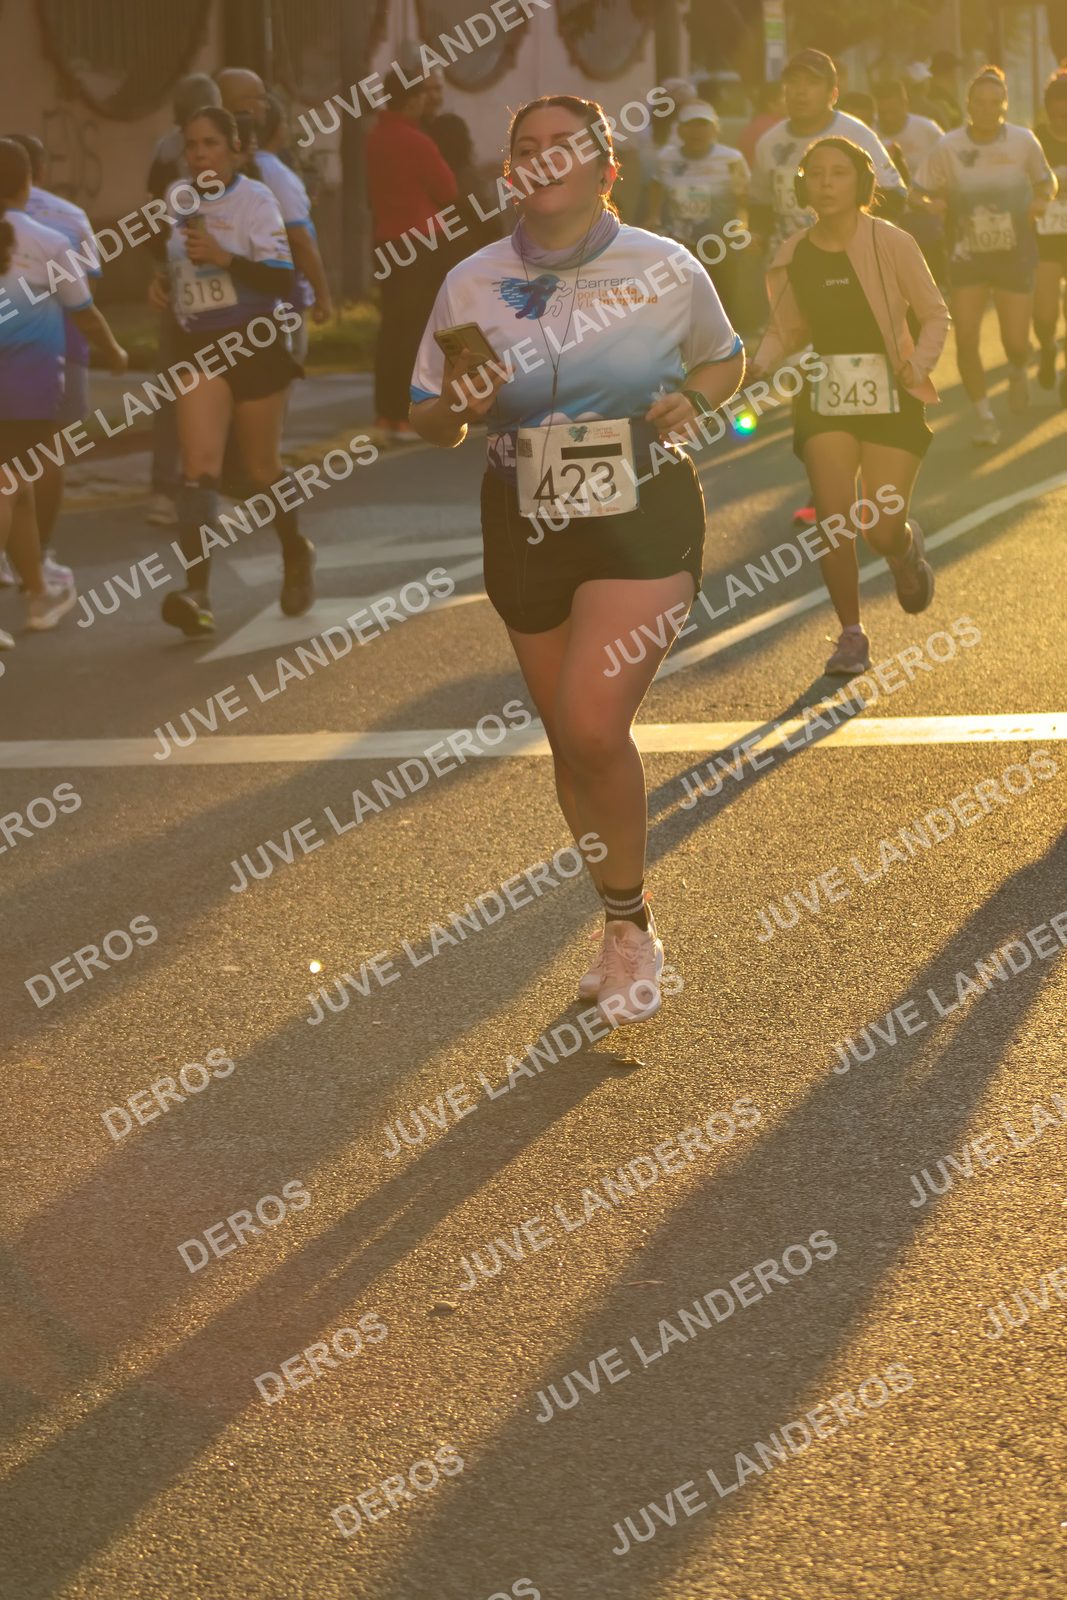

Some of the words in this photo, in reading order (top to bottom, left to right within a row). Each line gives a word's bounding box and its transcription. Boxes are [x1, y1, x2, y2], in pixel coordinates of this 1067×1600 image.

[183, 279, 224, 306] 518
[827, 380, 878, 408] 343
[533, 461, 617, 505] 423
